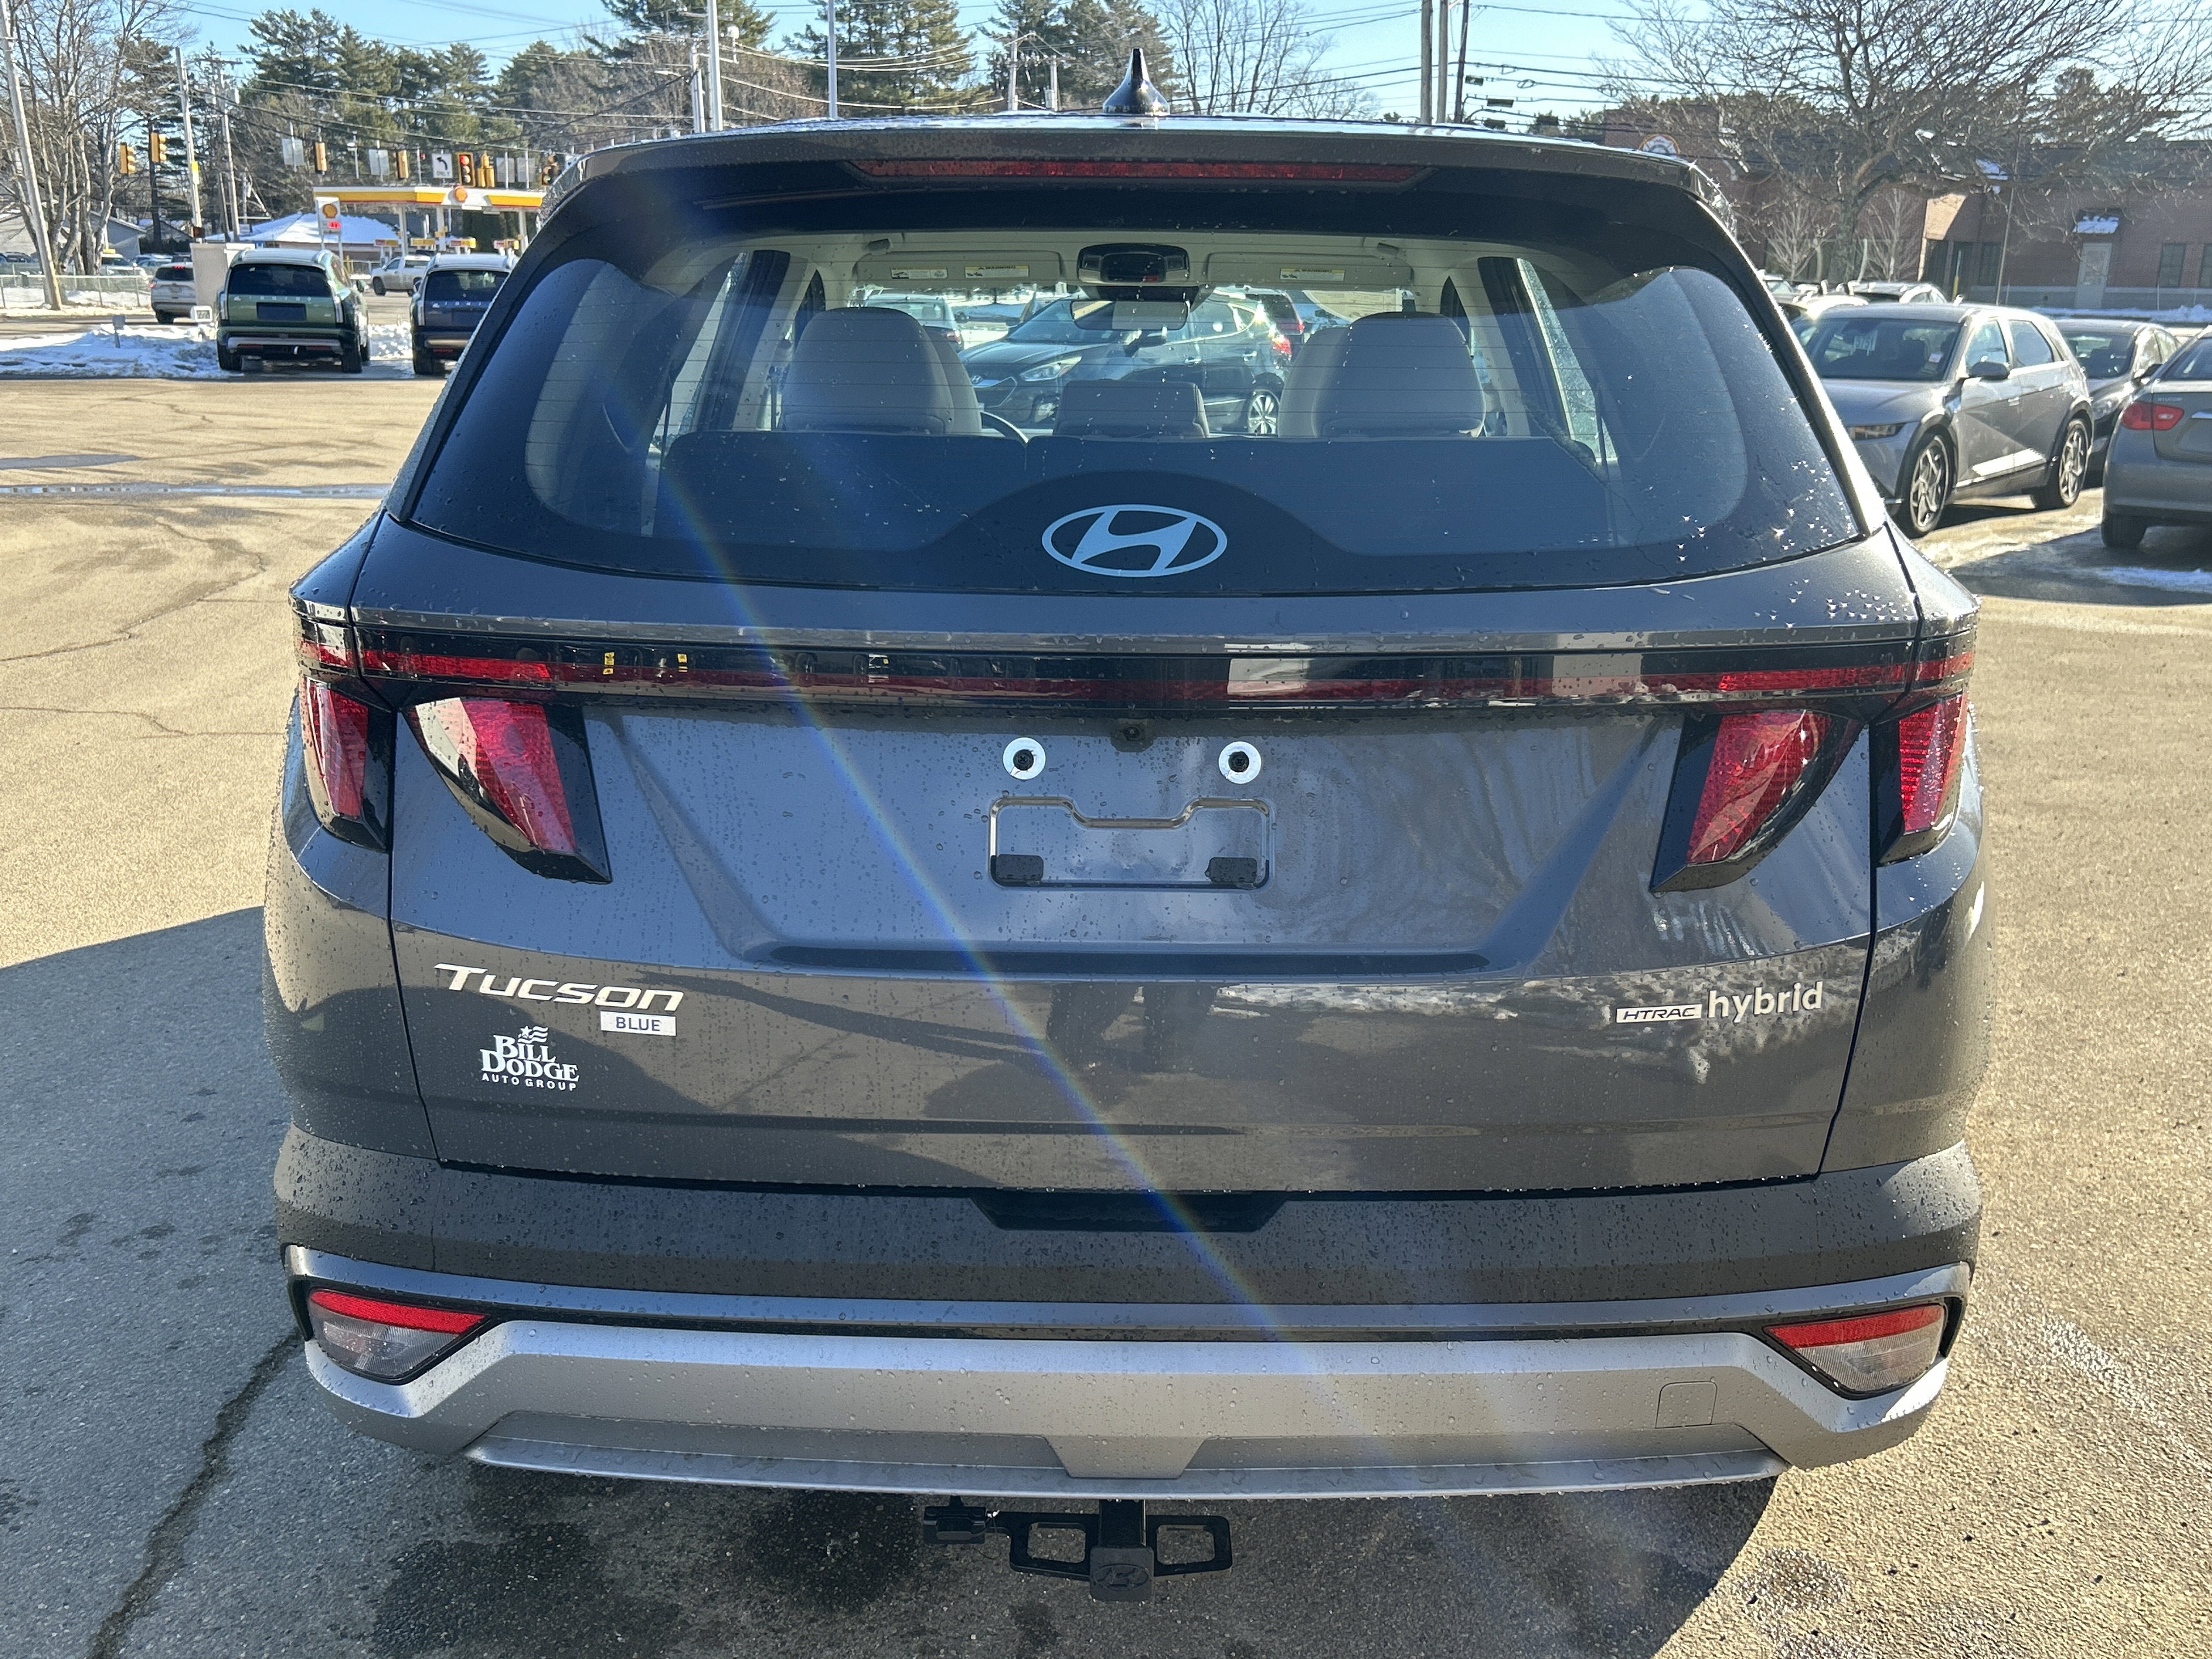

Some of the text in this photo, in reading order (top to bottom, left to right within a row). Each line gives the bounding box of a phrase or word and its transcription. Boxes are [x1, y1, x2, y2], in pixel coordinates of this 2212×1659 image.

[1622, 981, 1823, 1023] HTRAC hybrid
[616, 1017, 661, 1031] BLUE
[493, 1035, 556, 1063] BILL
[479, 1049, 580, 1082] DODGE
[482, 1073, 576, 1091] AUTO GROUP
